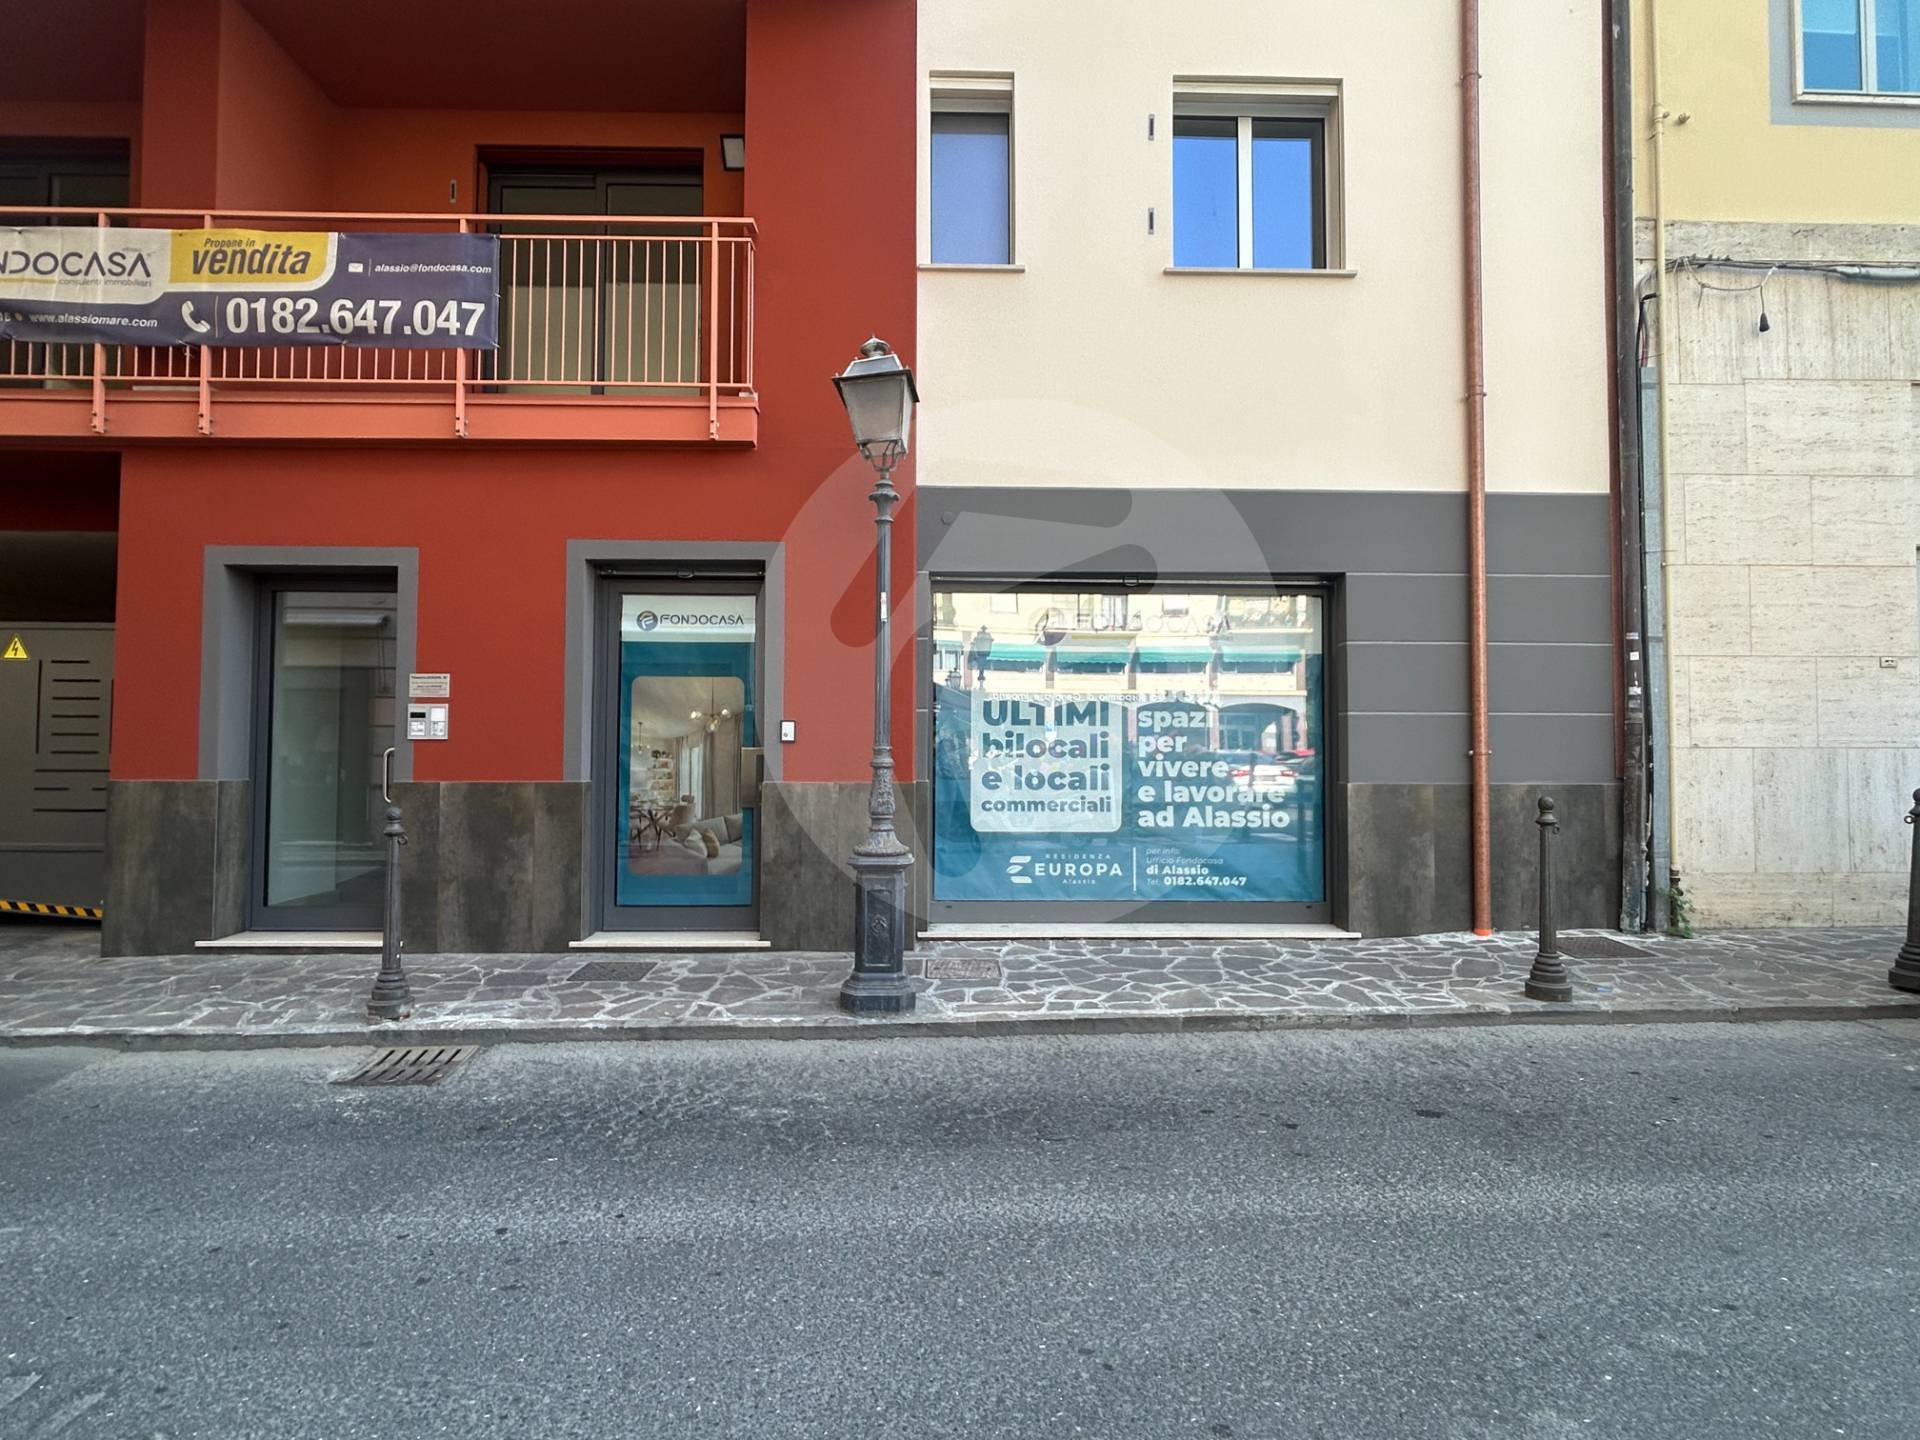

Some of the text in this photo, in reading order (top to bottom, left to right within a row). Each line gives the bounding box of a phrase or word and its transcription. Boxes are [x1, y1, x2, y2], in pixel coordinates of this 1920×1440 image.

[204, 237, 256, 250] Propone in
[192, 244, 311, 275] vendita
[374, 263, 492, 274] alassio@fondocasa.com
[29, 313, 158, 328] www.alassiomare.com
[226, 297, 486, 336] 0182.647.047
[659, 614, 744, 625] FONDOCASA
[982, 700, 1109, 726] ULTIMI
[982, 730, 1109, 758] bilocali
[1138, 734, 1187, 758] per
[981, 763, 1110, 791] e locali
[1138, 753, 1229, 778] vivere
[1137, 780, 1285, 803] e lavorare
[981, 795, 1111, 813] commerciali
[1138, 803, 1290, 828] ad Alassio
[1034, 863, 1124, 876] EUROPA
[1145, 864, 1210, 875] di Alassio
[1163, 876, 1247, 887] 0182.647.047
